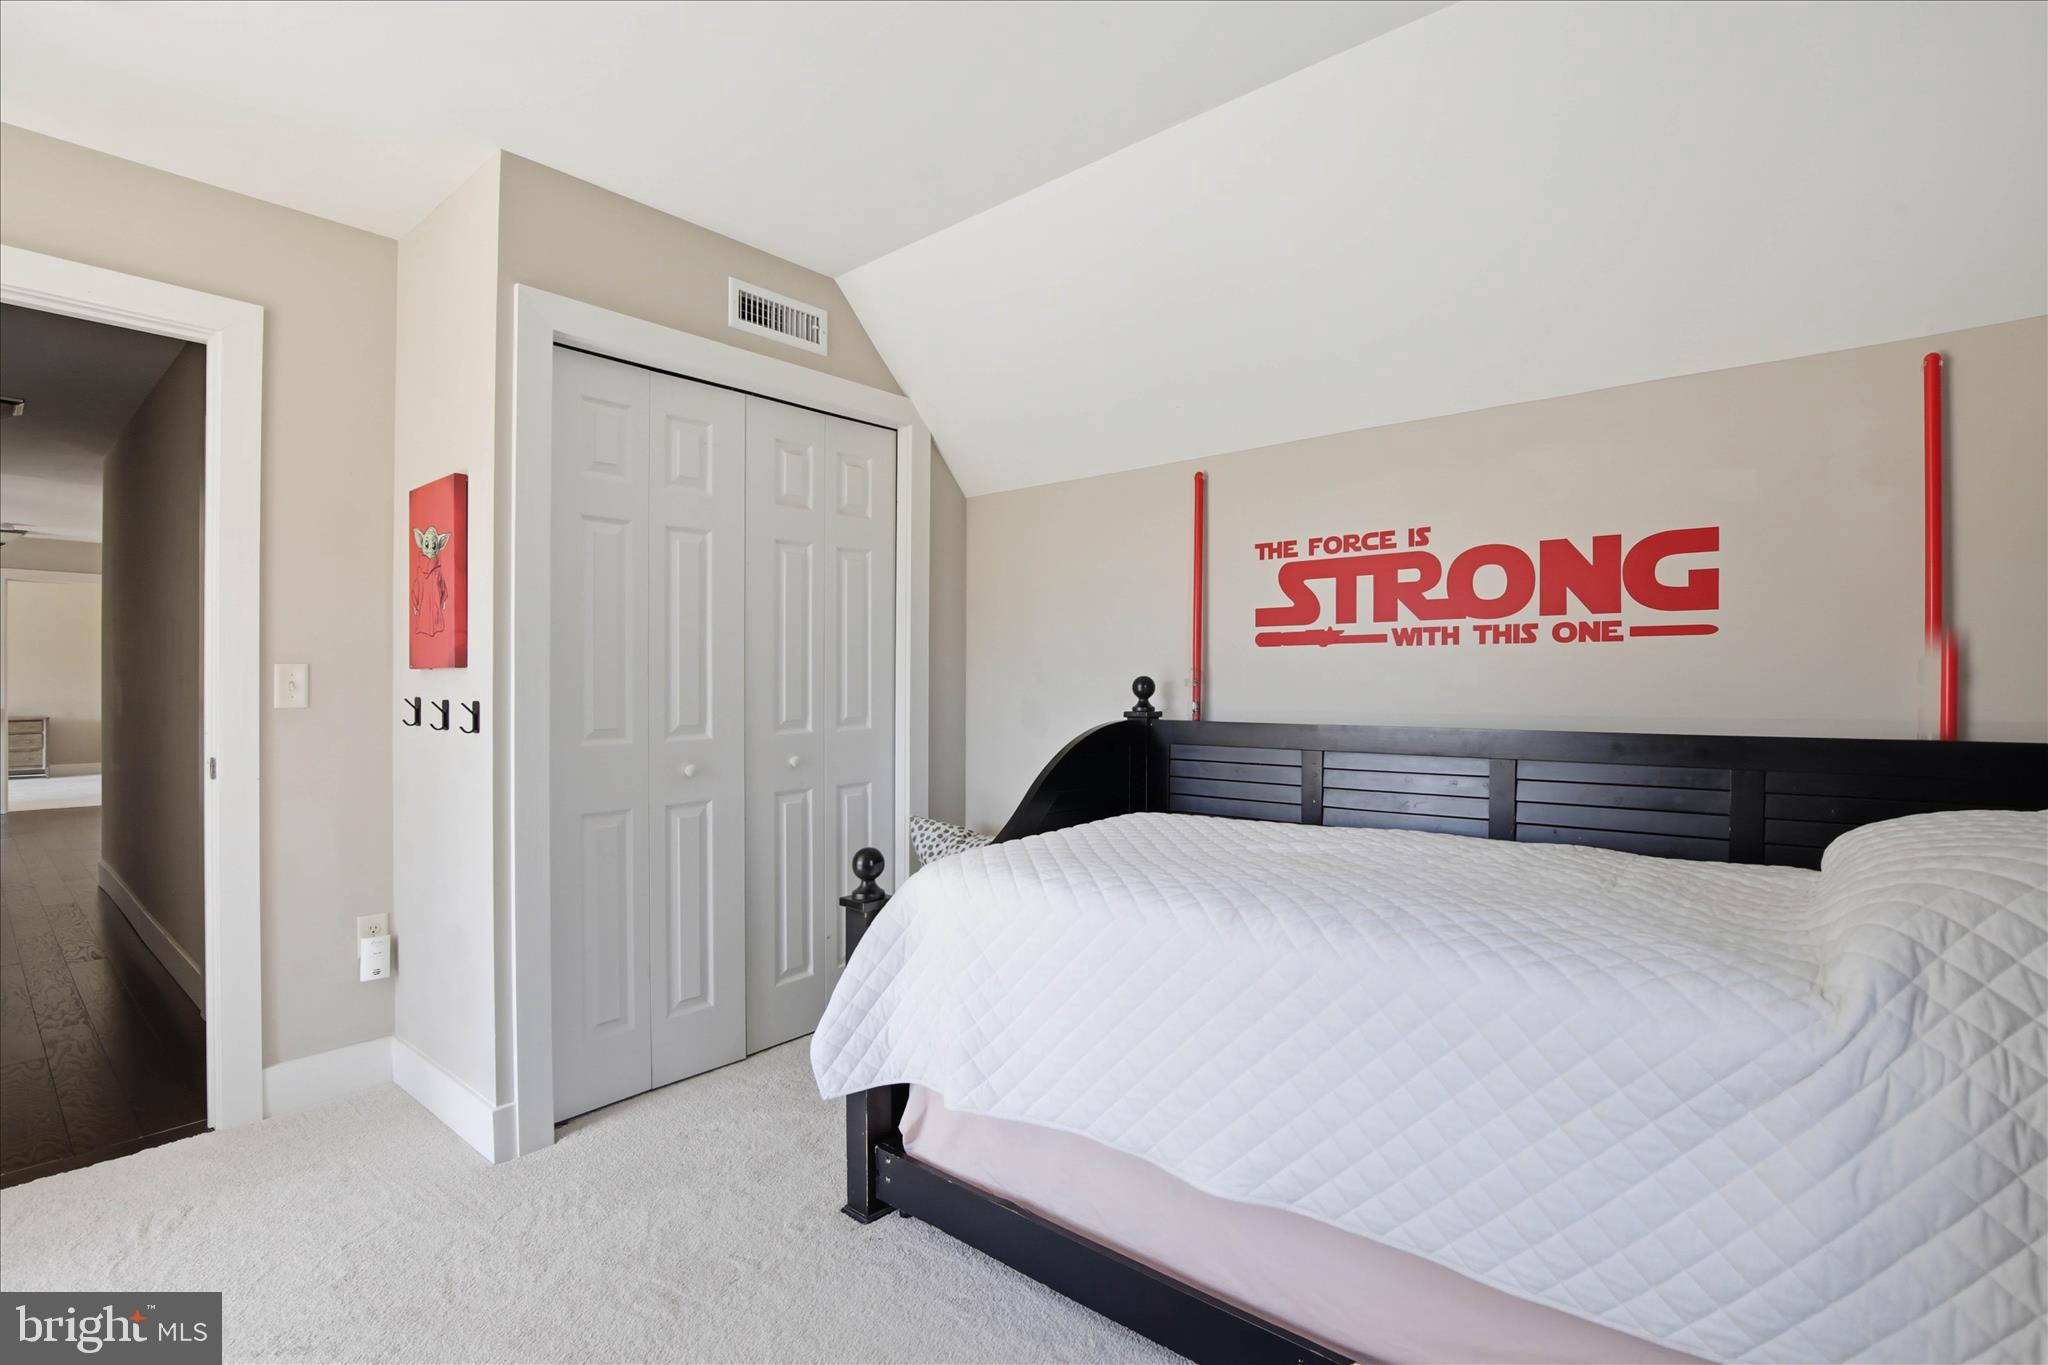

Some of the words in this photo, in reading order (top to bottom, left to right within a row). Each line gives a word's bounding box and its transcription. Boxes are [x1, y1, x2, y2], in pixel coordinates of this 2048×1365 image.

[1255, 540, 1298, 561] THE
[1308, 530, 1397, 557] FORCE
[1408, 526, 1432, 547] IS
[1255, 526, 1720, 627] STRONG
[1393, 626, 1460, 647] WITH
[1473, 624, 1540, 645] THIS
[1552, 620, 1624, 644] ONE
